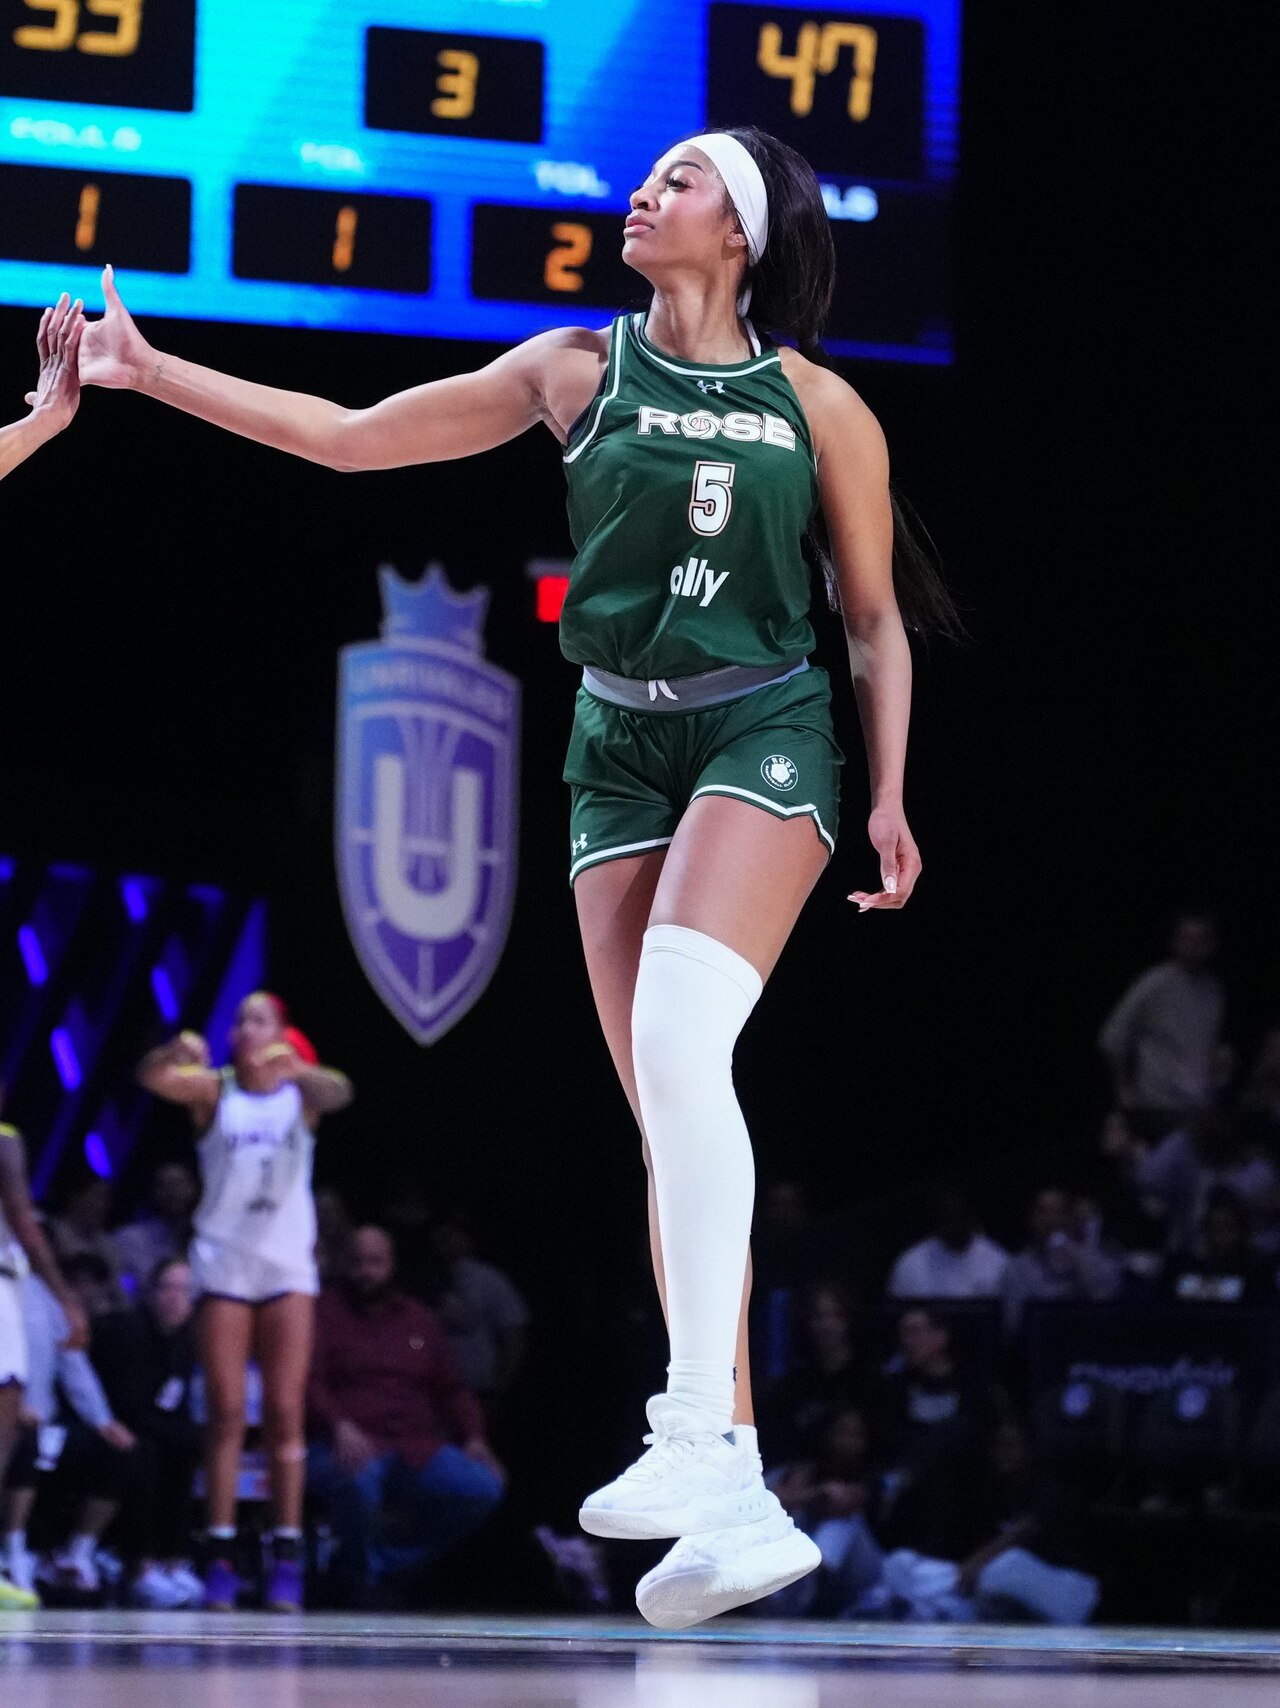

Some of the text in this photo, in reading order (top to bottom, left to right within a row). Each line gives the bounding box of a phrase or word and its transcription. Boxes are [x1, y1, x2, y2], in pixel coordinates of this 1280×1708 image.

[430, 49, 480, 120] 3
[756, 20, 878, 122] 47
[74, 184, 101, 251] 1
[331, 205, 358, 272] 1
[543, 221, 594, 293] 2
[637, 405, 796, 452] ROSE
[688, 460, 736, 537] 5
[670, 556, 731, 608] ally
